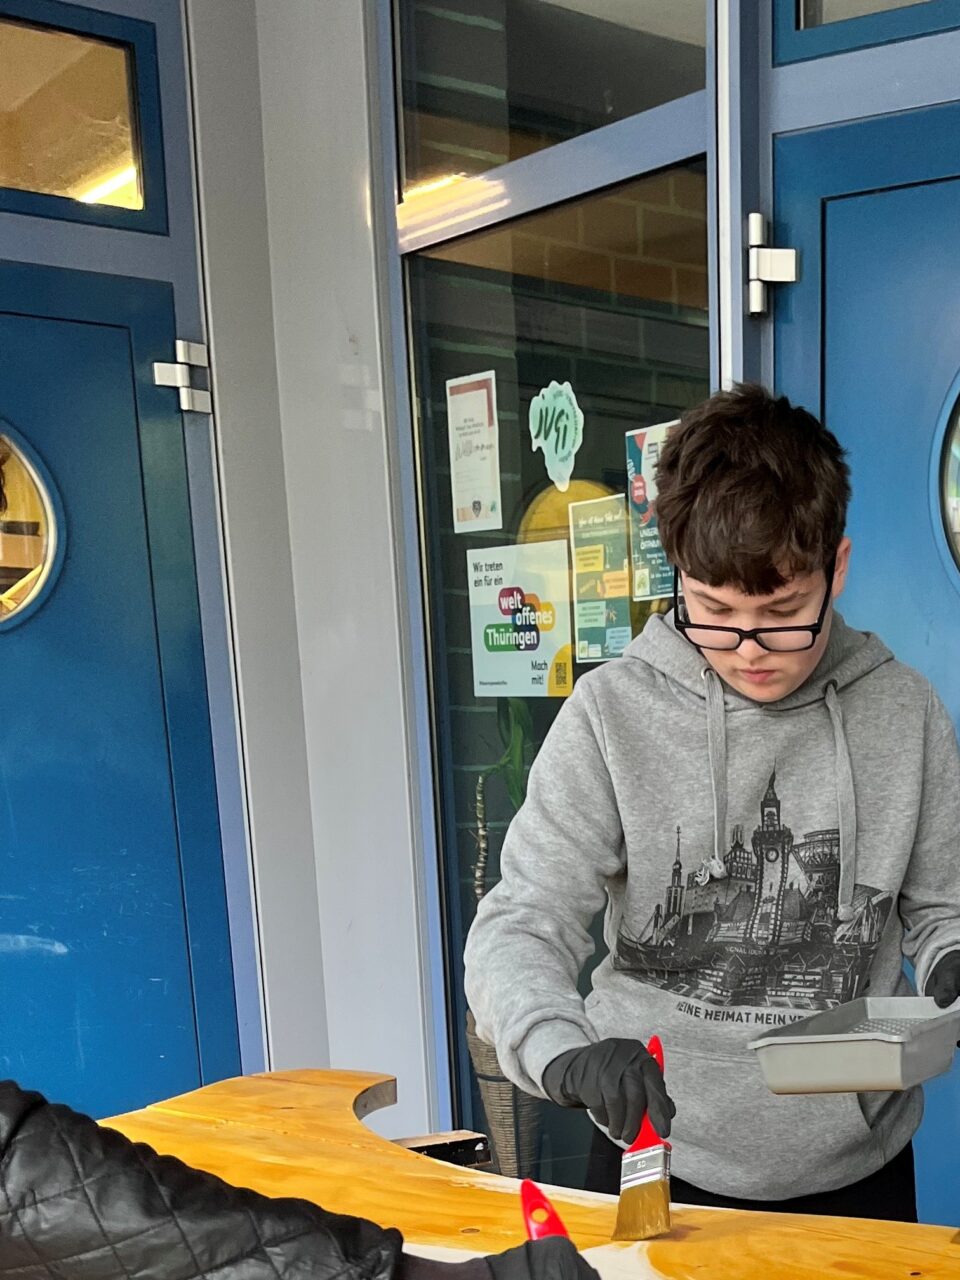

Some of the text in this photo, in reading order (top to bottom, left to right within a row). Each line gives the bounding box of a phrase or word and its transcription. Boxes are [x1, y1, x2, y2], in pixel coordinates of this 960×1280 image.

[473, 561, 503, 572] Wir treten
[474, 578, 483, 587] ein
[494, 577, 503, 586] ein
[500, 591, 522, 610] welt
[516, 607, 553, 625] offenes
[486, 628, 537, 649] Thüringen
[531, 660, 548, 671] Mach
[531, 675, 544, 685] mit!
[704, 1009, 752, 1023] HEIMAT
[754, 1012, 786, 1026] MEIN
